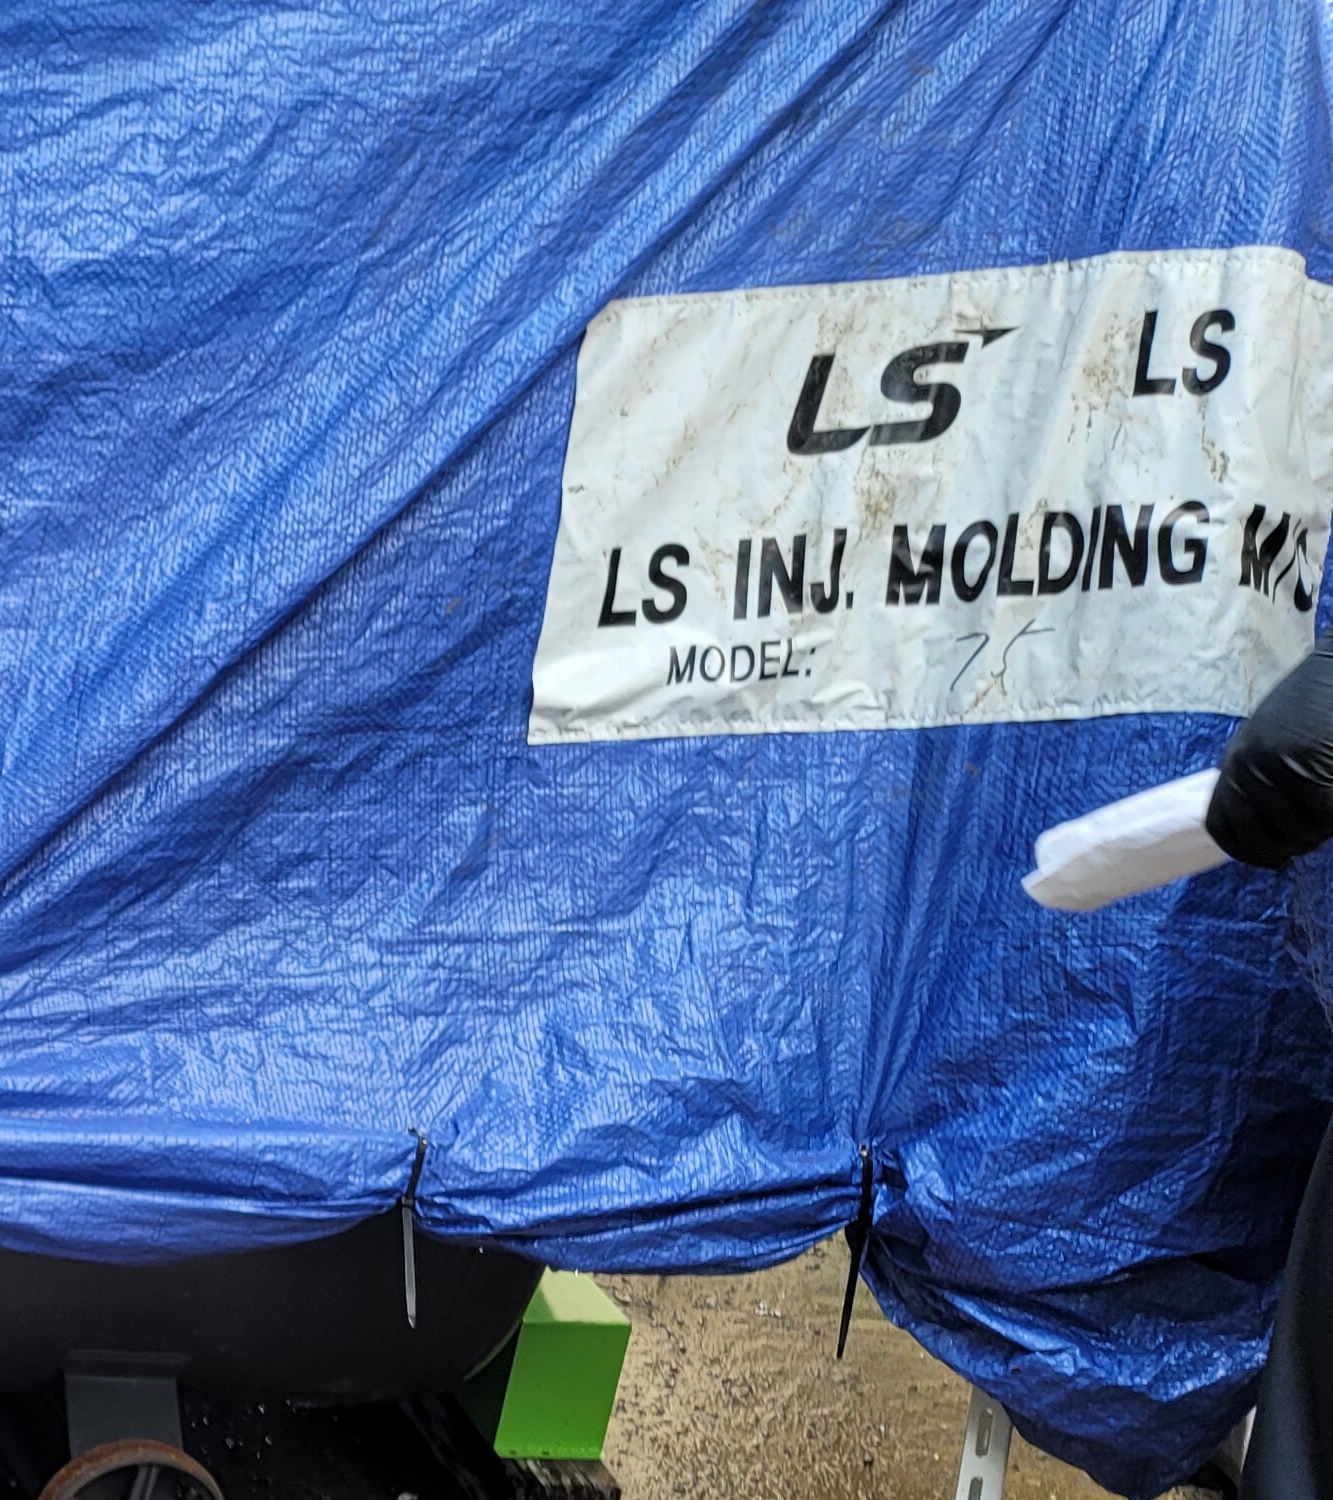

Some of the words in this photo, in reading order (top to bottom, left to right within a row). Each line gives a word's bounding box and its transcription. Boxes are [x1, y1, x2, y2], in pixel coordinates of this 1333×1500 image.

[787, 341, 970, 456] LS
[1132, 309, 1236, 396] LS
[597, 543, 690, 628] LS
[733, 528, 854, 620] INJ.
[885, 501, 1211, 607] MOLDING
[666, 638, 817, 685] MODEL:
